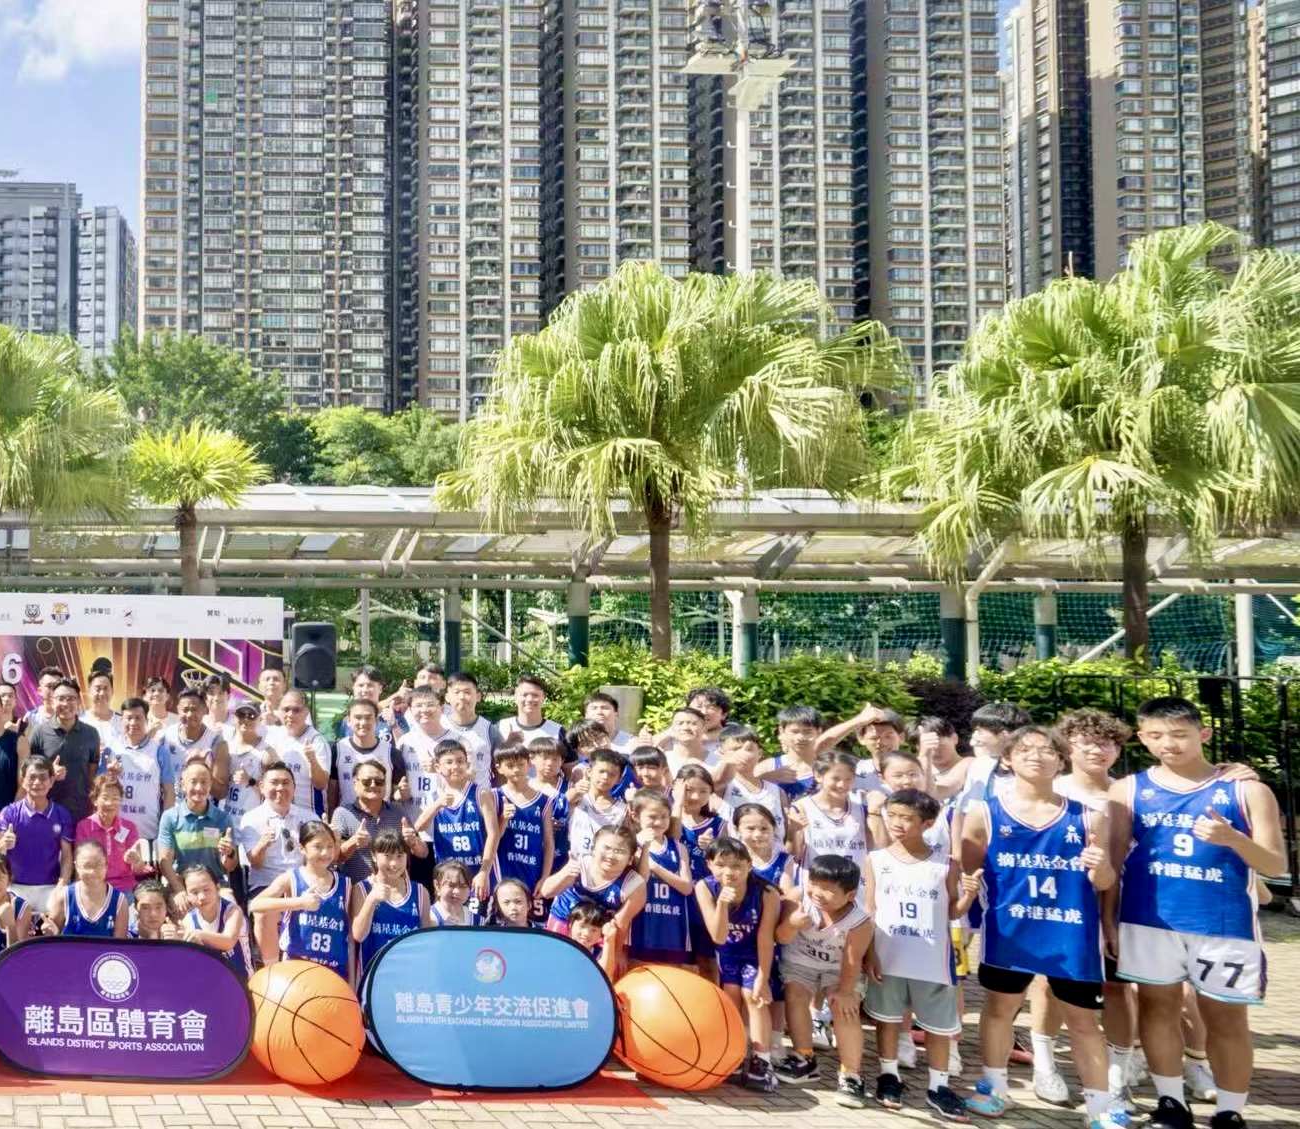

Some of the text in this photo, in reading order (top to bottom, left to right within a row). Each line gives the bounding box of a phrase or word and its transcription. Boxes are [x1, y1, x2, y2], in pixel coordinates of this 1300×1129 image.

[417, 777, 431, 792] 18
[452, 836, 471, 852] 68
[514, 833, 529, 850] 31
[1173, 833, 1194, 857] 9
[1148, 861, 1225, 883] 香港猛虎
[653, 882, 670, 899] 10
[1027, 875, 1058, 899] 14
[899, 901, 918, 919] 19
[1008, 903, 1084, 924] 香港猛虎
[311, 932, 332, 953] 83
[1196, 957, 1245, 989] 77
[395, 991, 589, 1019] 離島青少年交流促進會
[24, 1004, 208, 1040] 離島區體育會
[27, 1037, 205, 1052] ISLANDS DISTRICT SPORTS ASSOCIATION
